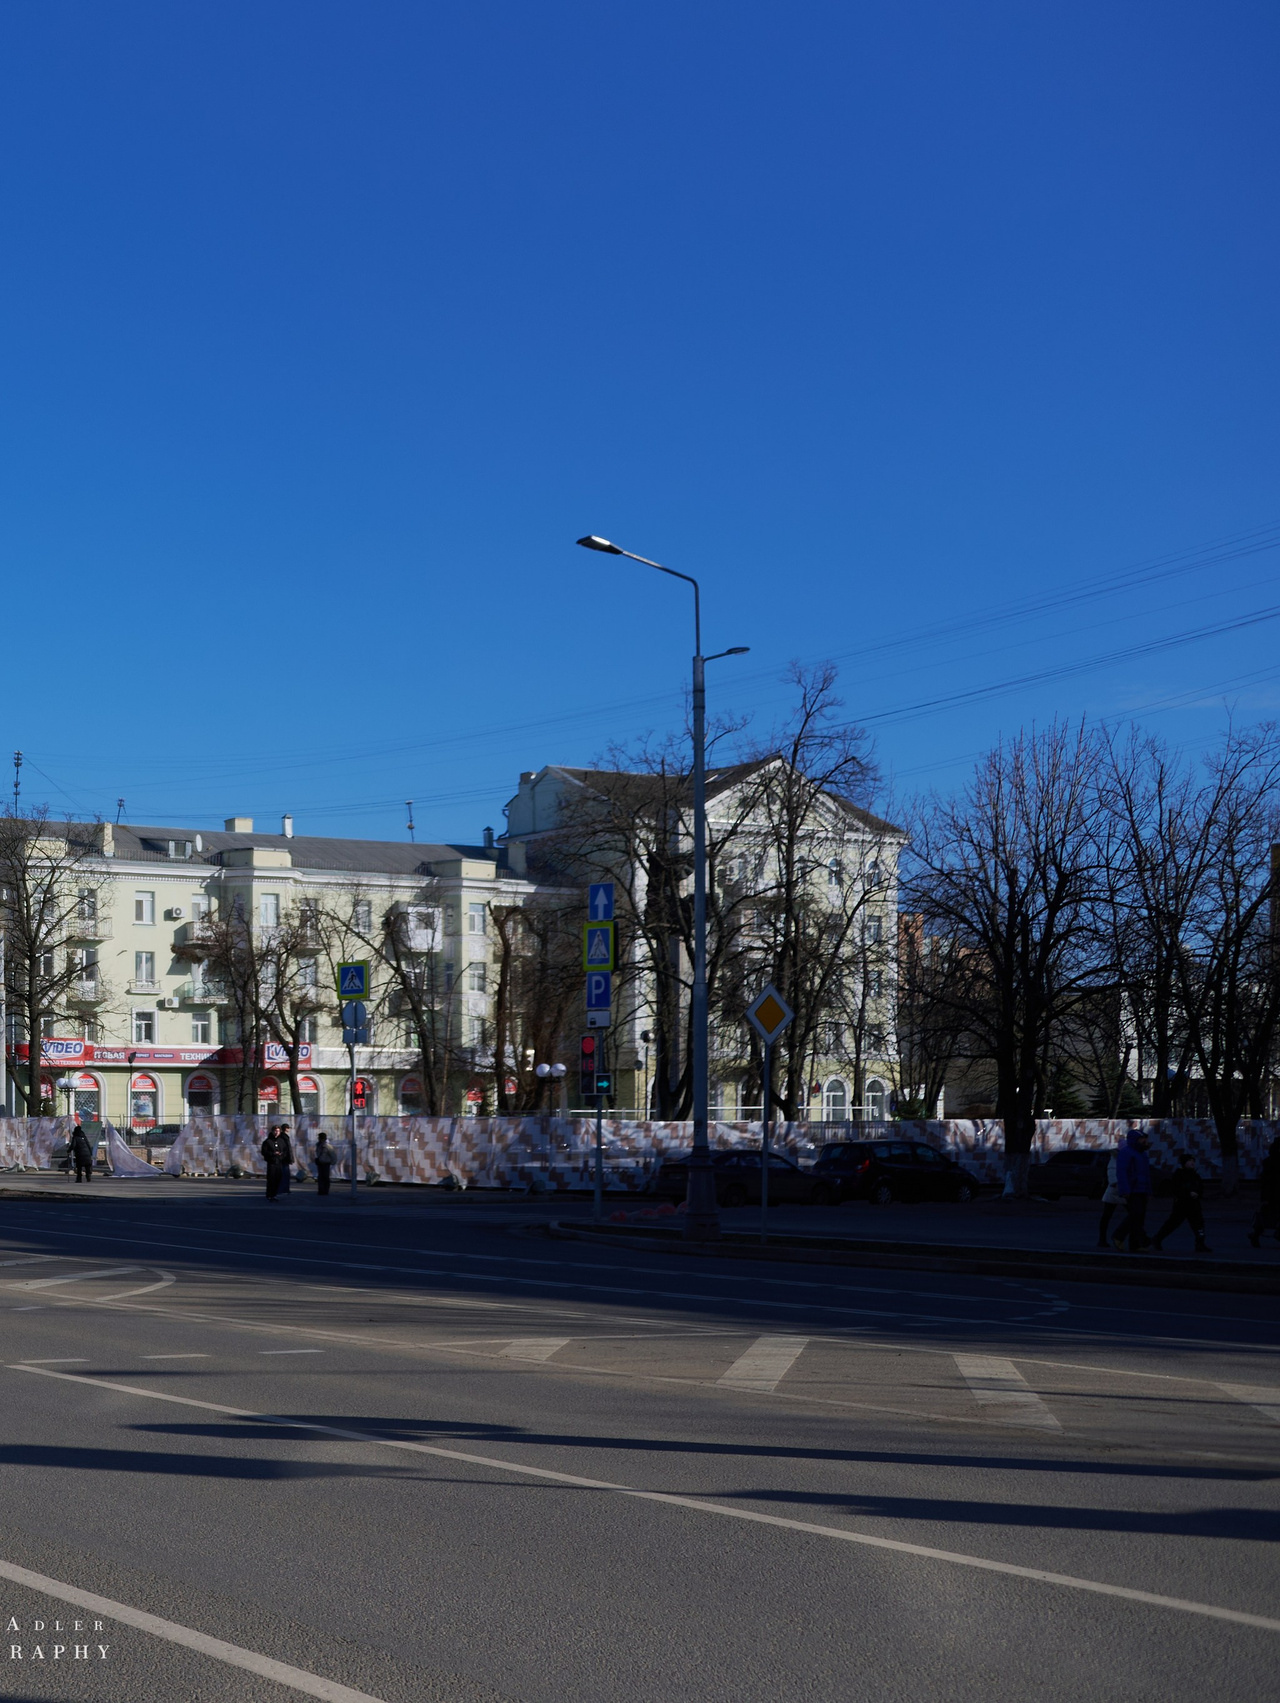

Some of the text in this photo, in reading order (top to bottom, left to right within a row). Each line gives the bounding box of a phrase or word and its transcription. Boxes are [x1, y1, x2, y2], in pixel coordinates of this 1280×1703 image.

[591, 975, 605, 1005] P
[40, 1040, 83, 1055] VIDEO
[94, 1051, 125, 1060] ТОВАЯ
[180, 1052, 219, 1060] ТЕХНИКА
